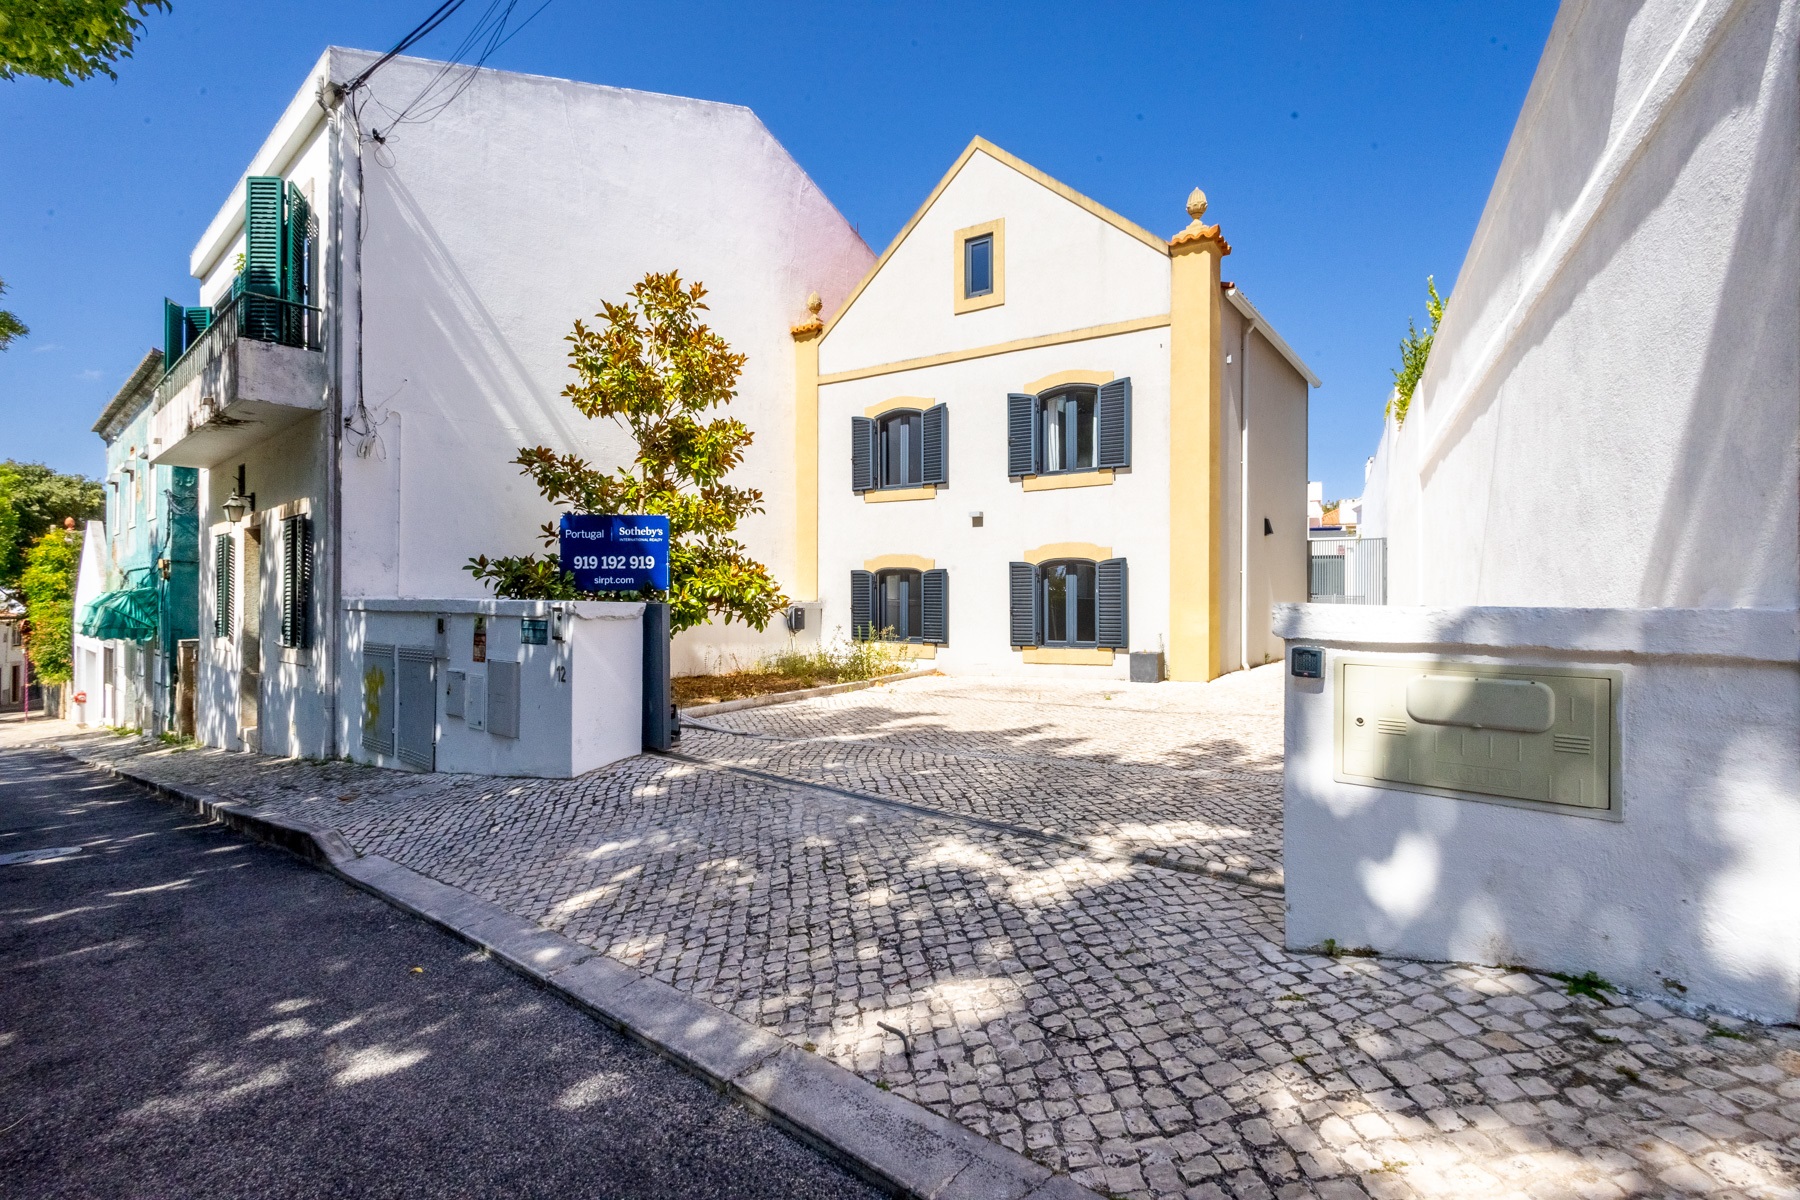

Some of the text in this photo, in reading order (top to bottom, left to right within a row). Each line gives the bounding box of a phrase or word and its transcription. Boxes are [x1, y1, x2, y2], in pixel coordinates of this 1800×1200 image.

[565, 529, 604, 540] Portugal
[619, 526, 663, 538] Sotheby's
[573, 555, 655, 570] 919 192 919
[594, 576, 634, 585] sirpt.com
[556, 665, 566, 683] 12
